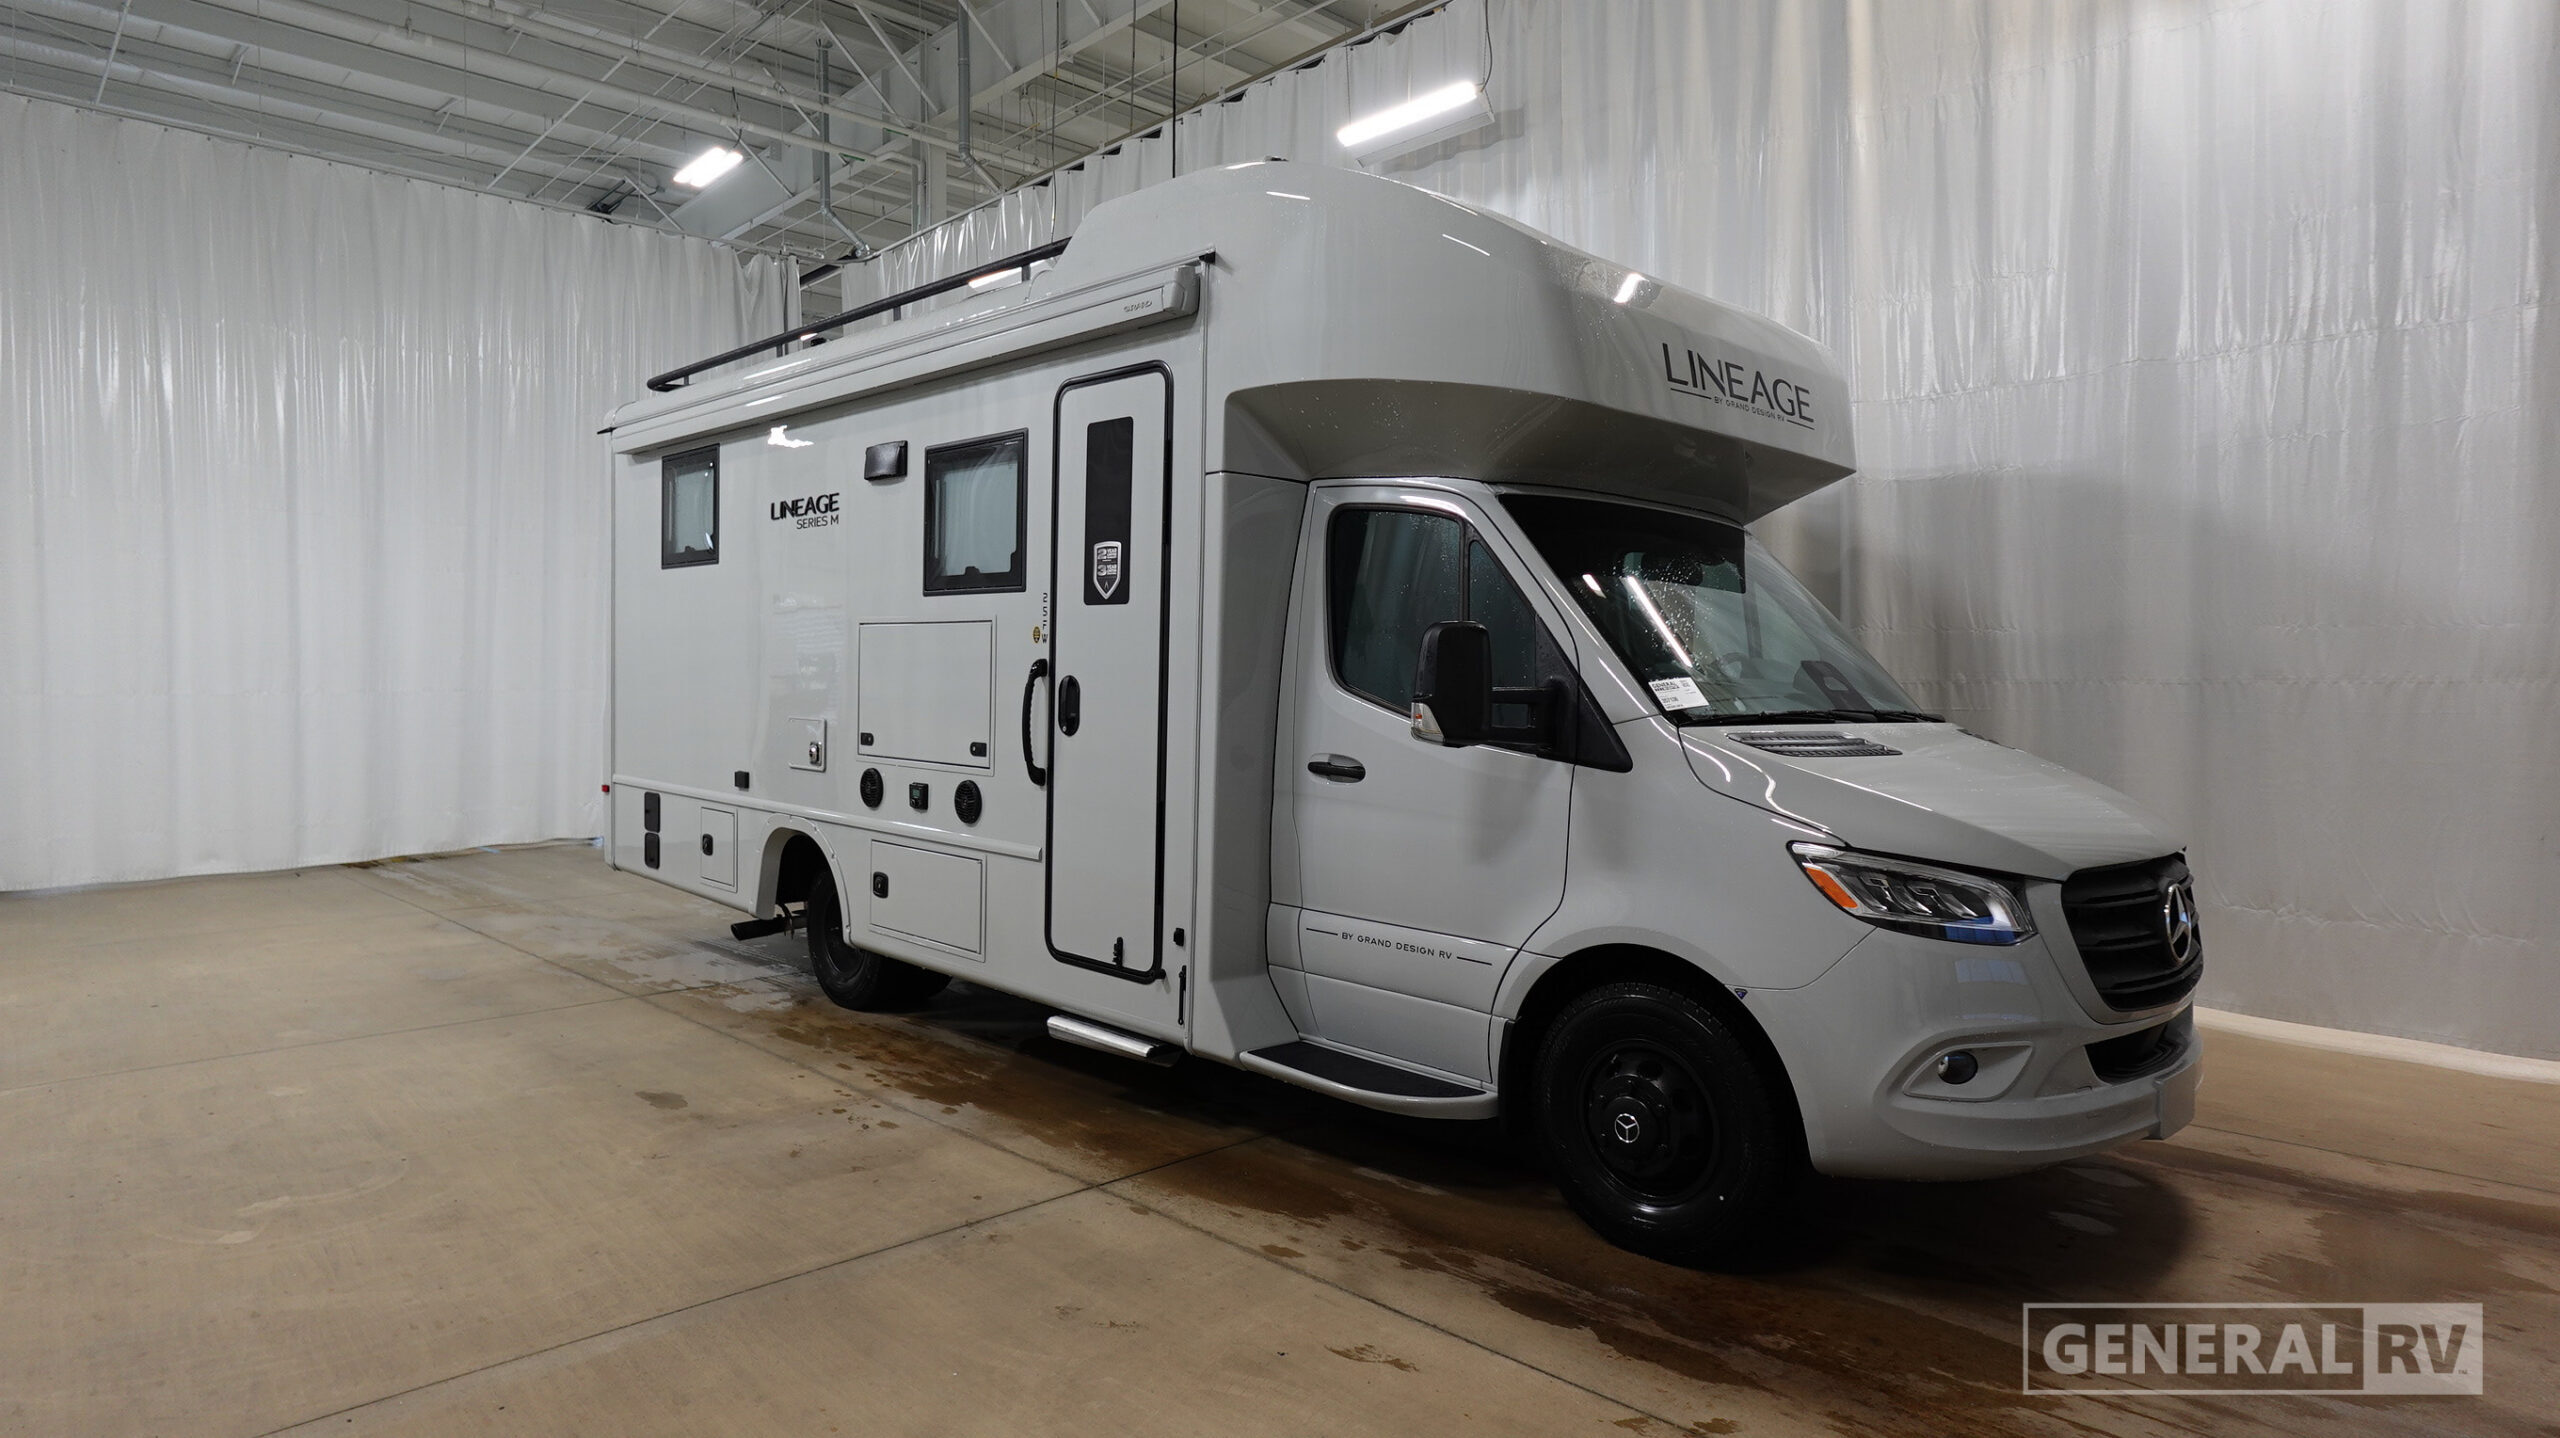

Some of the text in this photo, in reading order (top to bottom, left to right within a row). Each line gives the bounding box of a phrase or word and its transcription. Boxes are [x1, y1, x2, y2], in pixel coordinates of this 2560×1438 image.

[1662, 342, 1815, 423] LINEAGE
[1726, 399, 1750, 412] GRAND
[1751, 406, 1776, 419] DESIGN
[771, 492, 840, 521] LINEAGE
[796, 514, 840, 530] SERIES M
[1097, 548, 1107, 560] 2
[1097, 564, 1107, 576] 3
[1341, 931, 1453, 960] BY GRAND DESIGN RV
